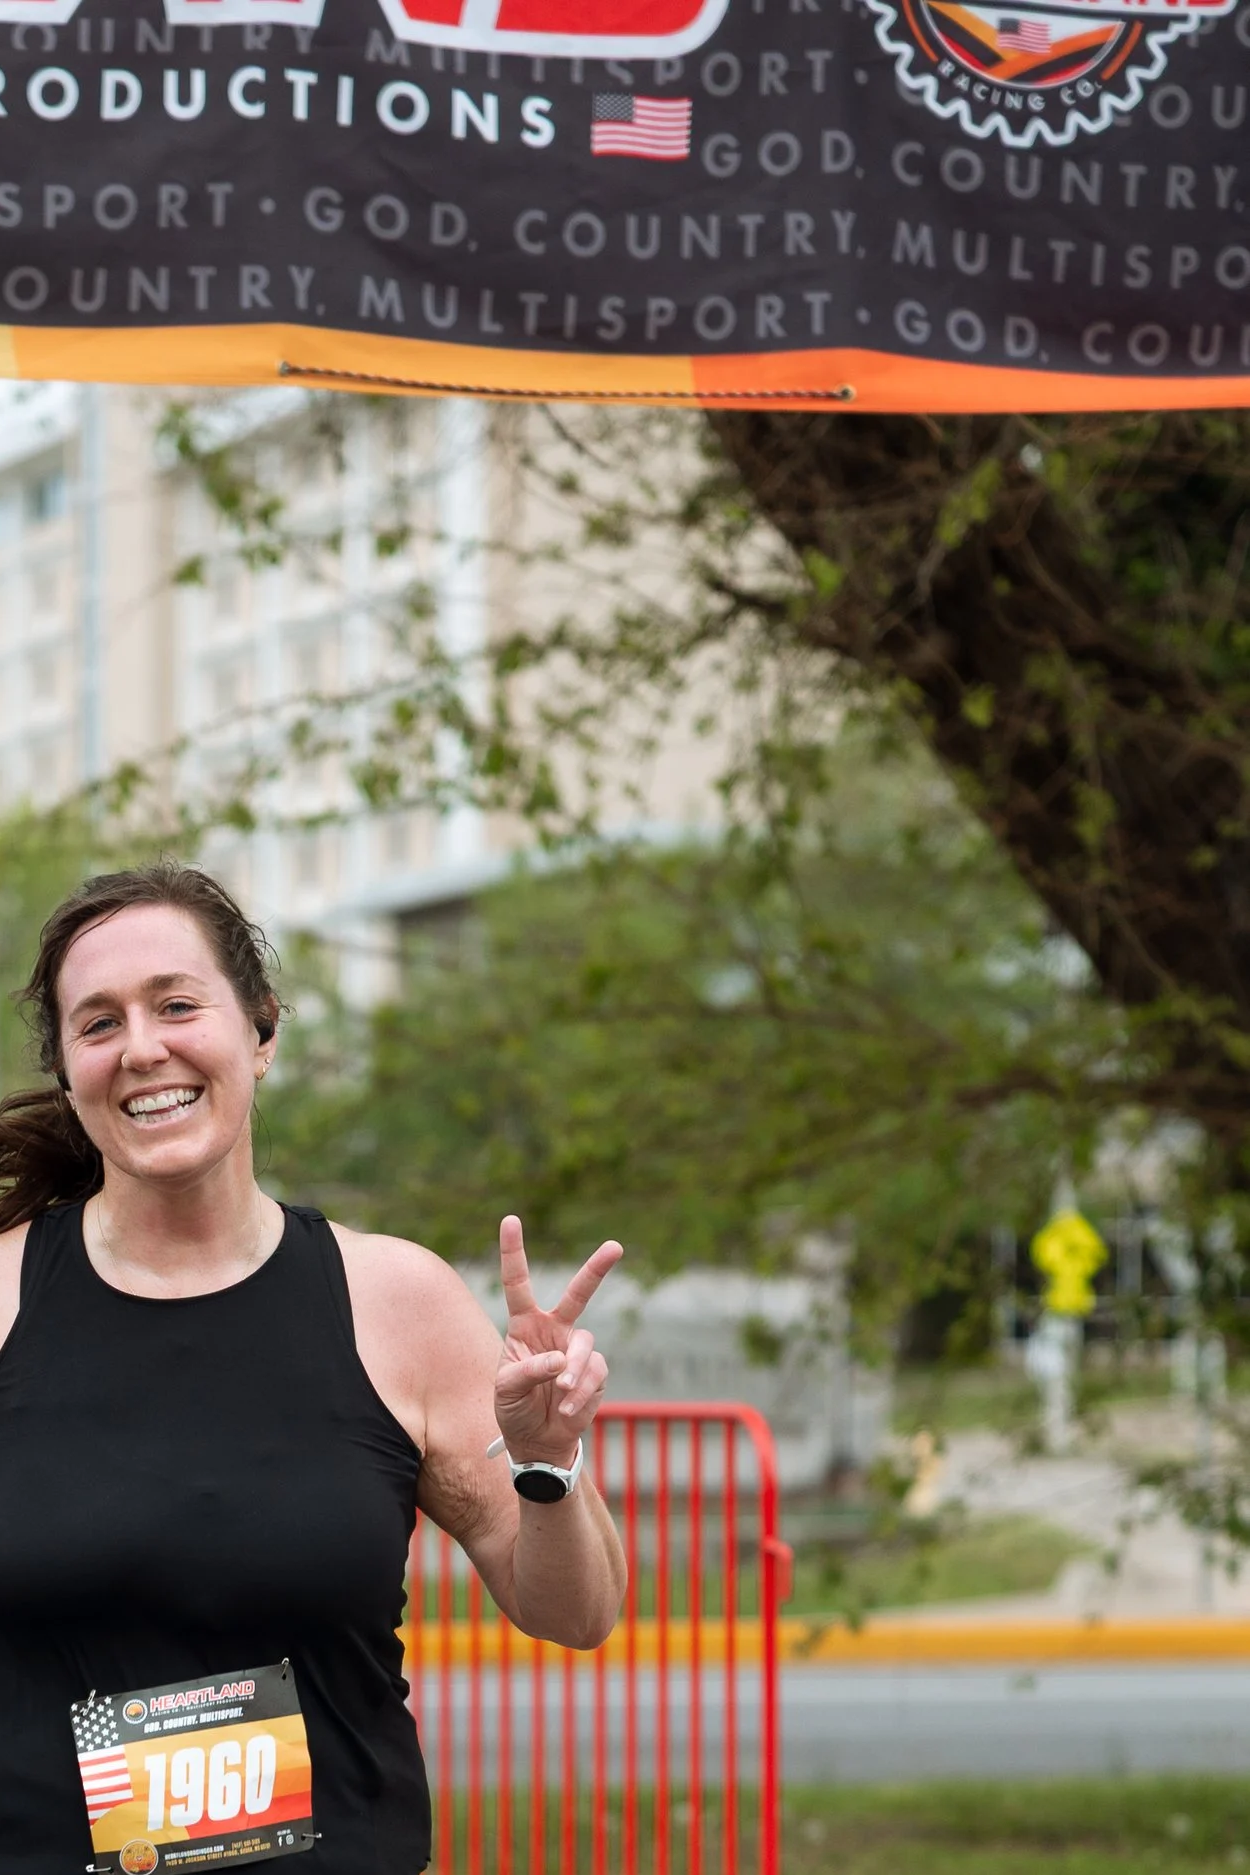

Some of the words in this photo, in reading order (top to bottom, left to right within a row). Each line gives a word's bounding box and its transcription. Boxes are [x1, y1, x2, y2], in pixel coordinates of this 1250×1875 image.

[937, 58, 1047, 112] RACING
[891, 220, 1250, 290] MULTISPO
[359, 275, 833, 341] MULTISPORT
[149, 1680, 256, 1713] HEARTLAND
[199, 1707, 244, 1723] MULTISPORT.
[144, 1734, 276, 1832] 1960
